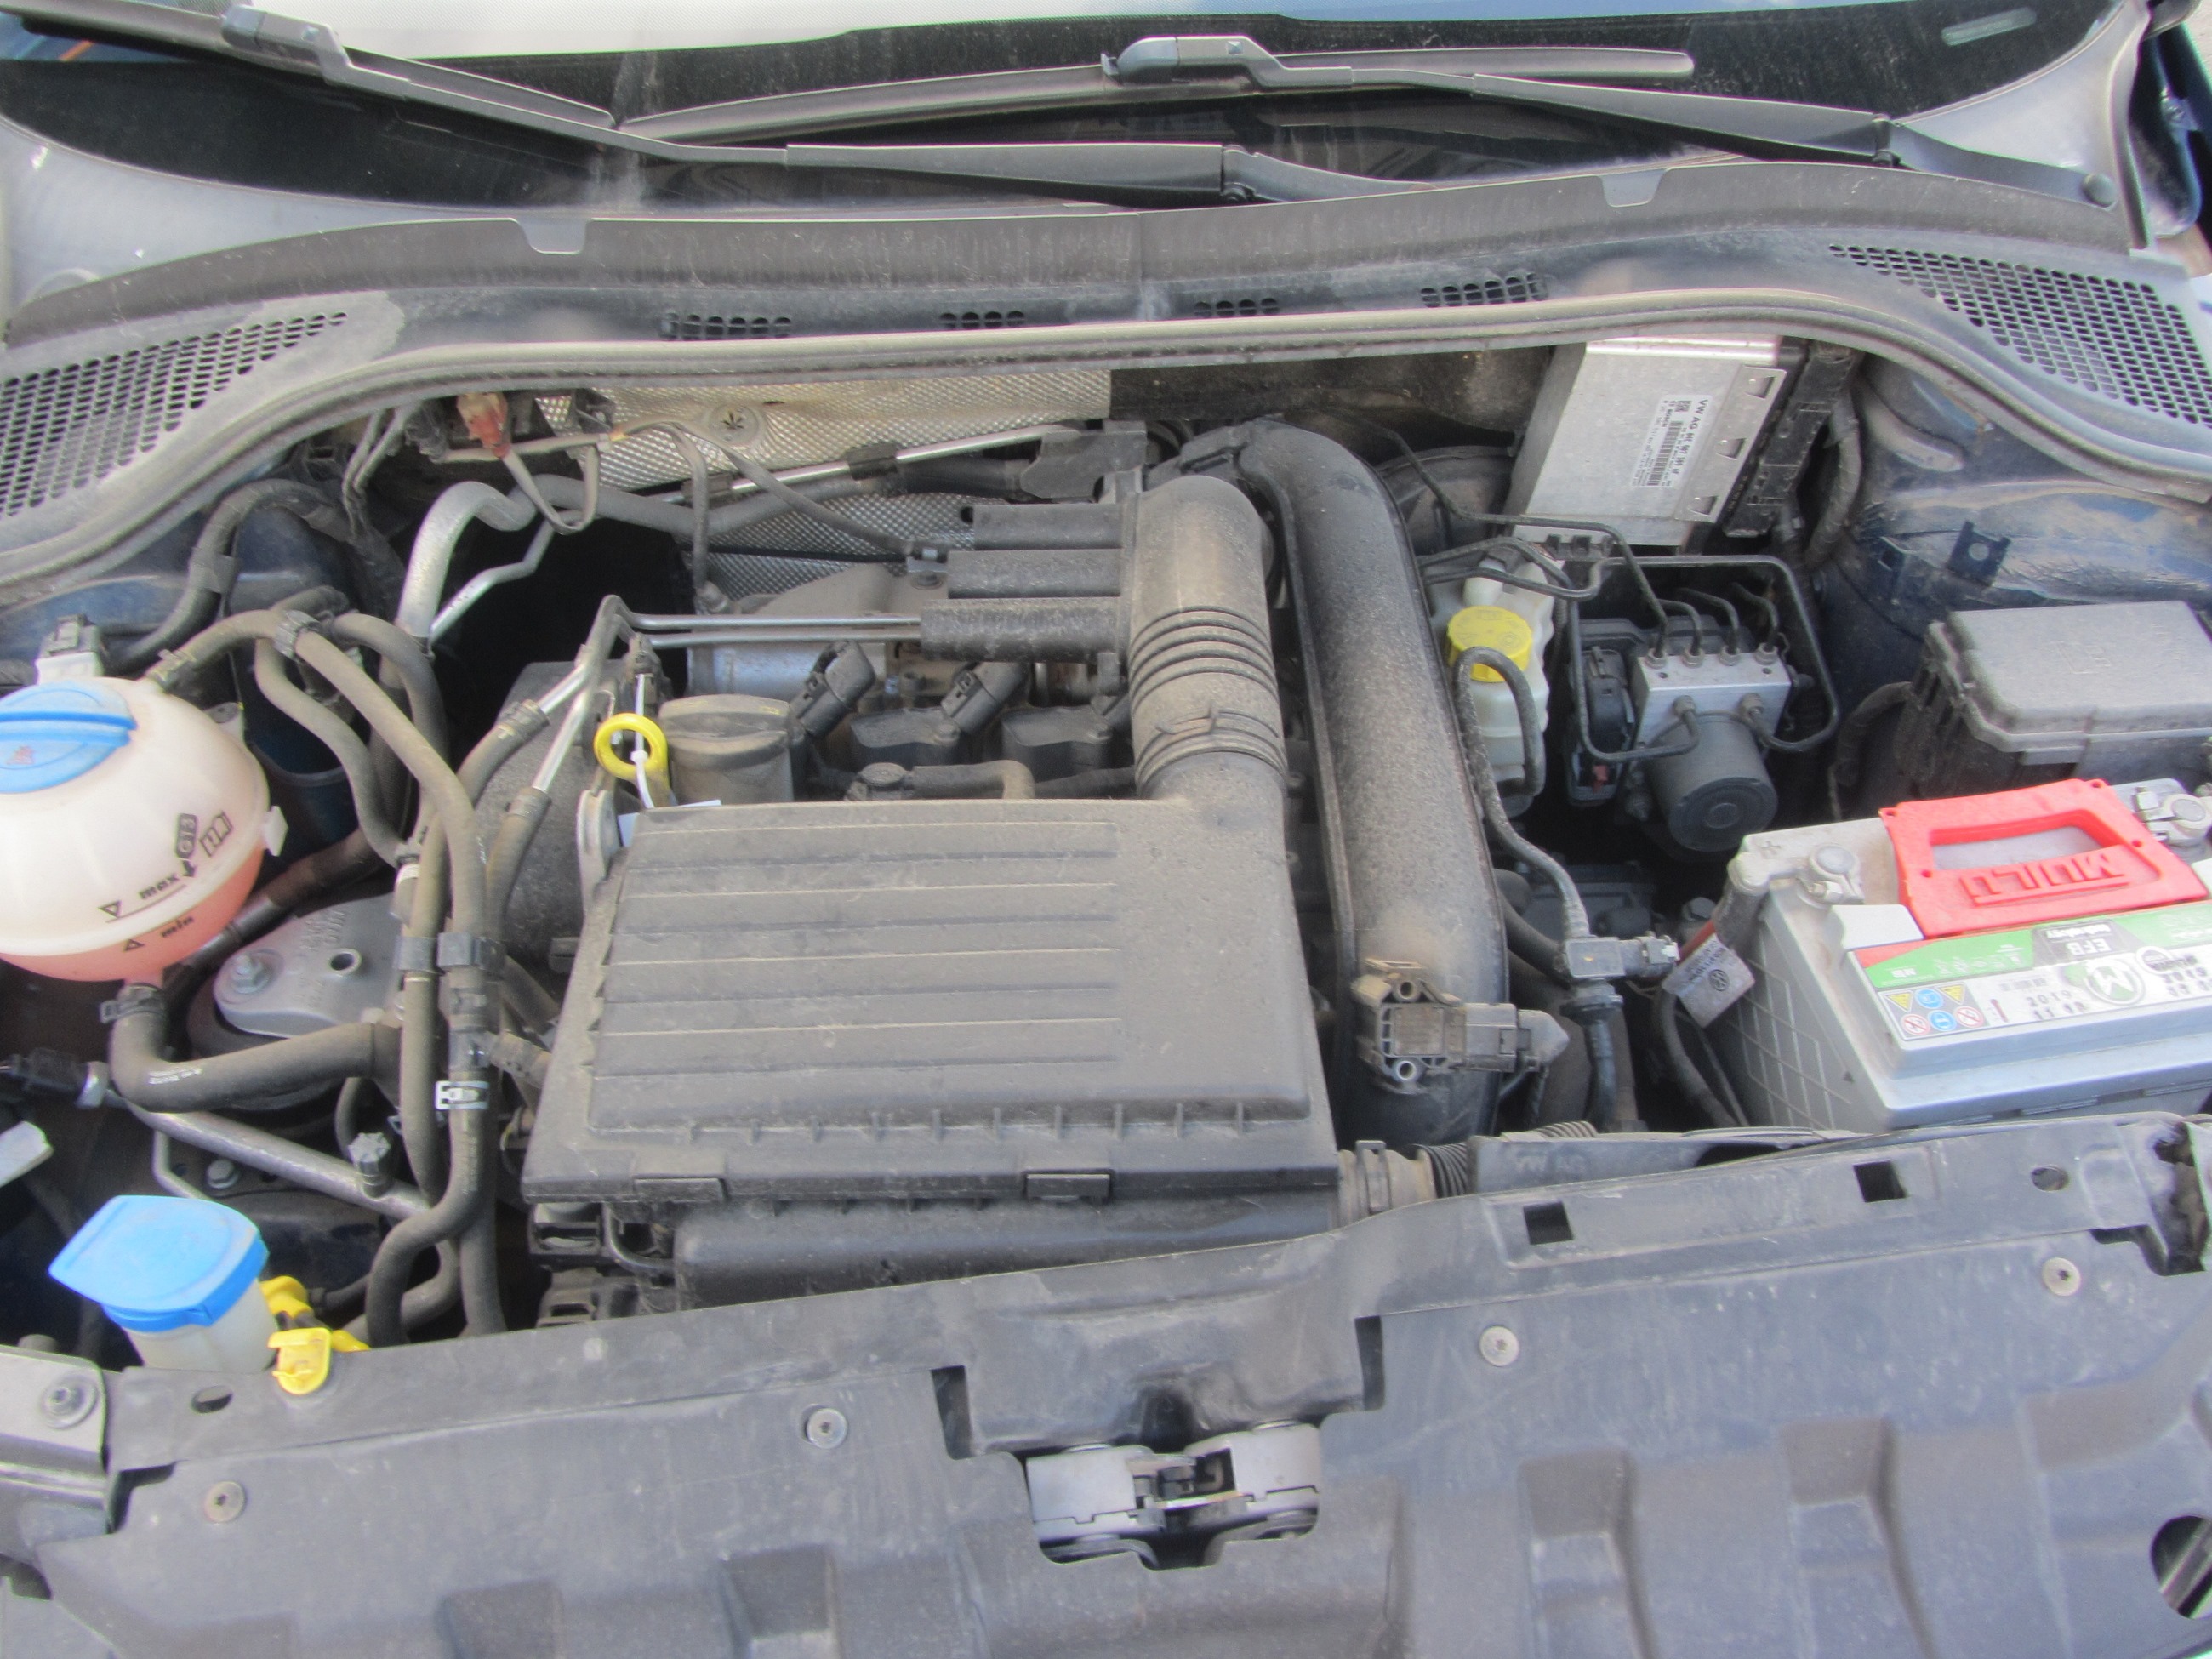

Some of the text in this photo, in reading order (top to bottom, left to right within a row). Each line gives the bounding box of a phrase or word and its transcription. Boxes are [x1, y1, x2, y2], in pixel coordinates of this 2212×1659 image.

[1695, 399, 1709, 414] VW
[1689, 416, 1701, 430] AG
[177, 816, 197, 855] G13
[139, 873, 180, 899] max
[161, 916, 195, 938] min
[2066, 938, 2112, 955] EFB
[2026, 989, 2073, 1007] 2019
